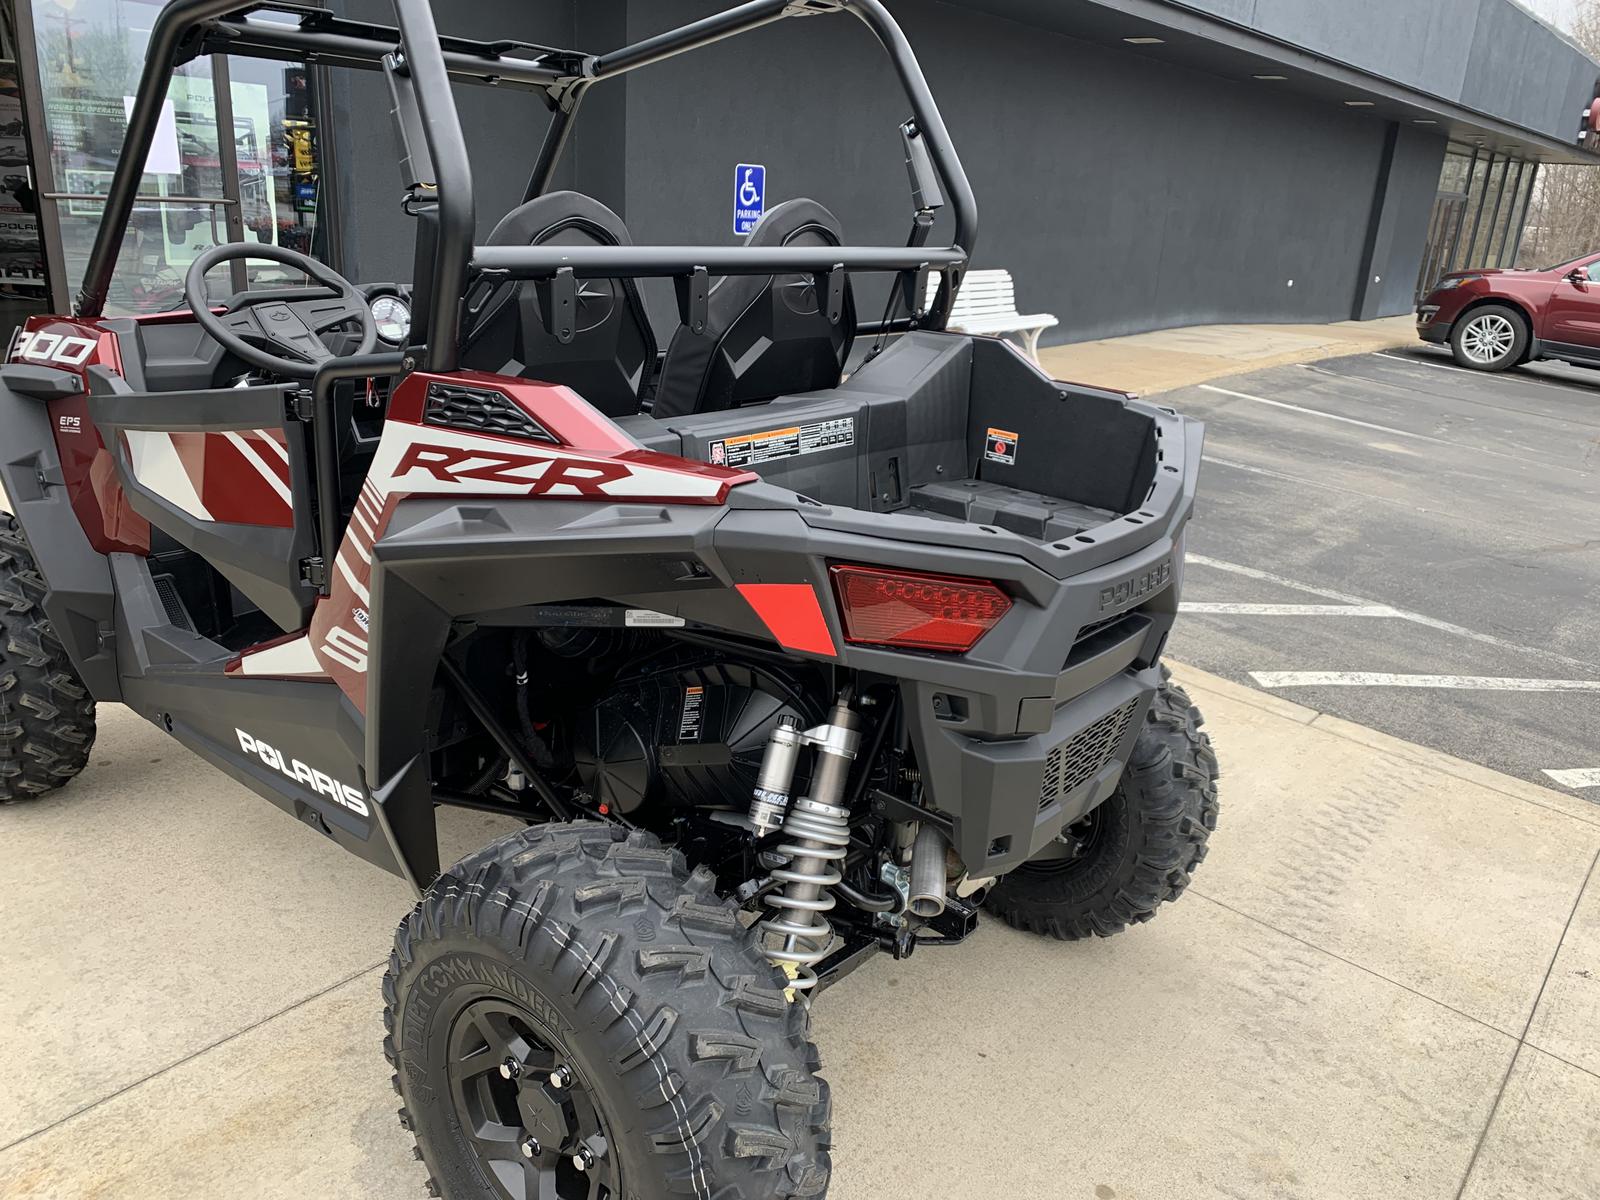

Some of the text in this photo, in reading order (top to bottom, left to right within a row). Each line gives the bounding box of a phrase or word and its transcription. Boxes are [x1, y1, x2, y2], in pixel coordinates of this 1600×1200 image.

[87, 106, 125, 115] OPERATIO
[737, 209, 761, 219] PARKING
[59, 416, 81, 426] EPS
[391, 442, 634, 496] RZR
[1098, 562, 1171, 611] POLARIS
[235, 727, 369, 817] POLARIS
[421, 958, 562, 1032] COMMANDER
